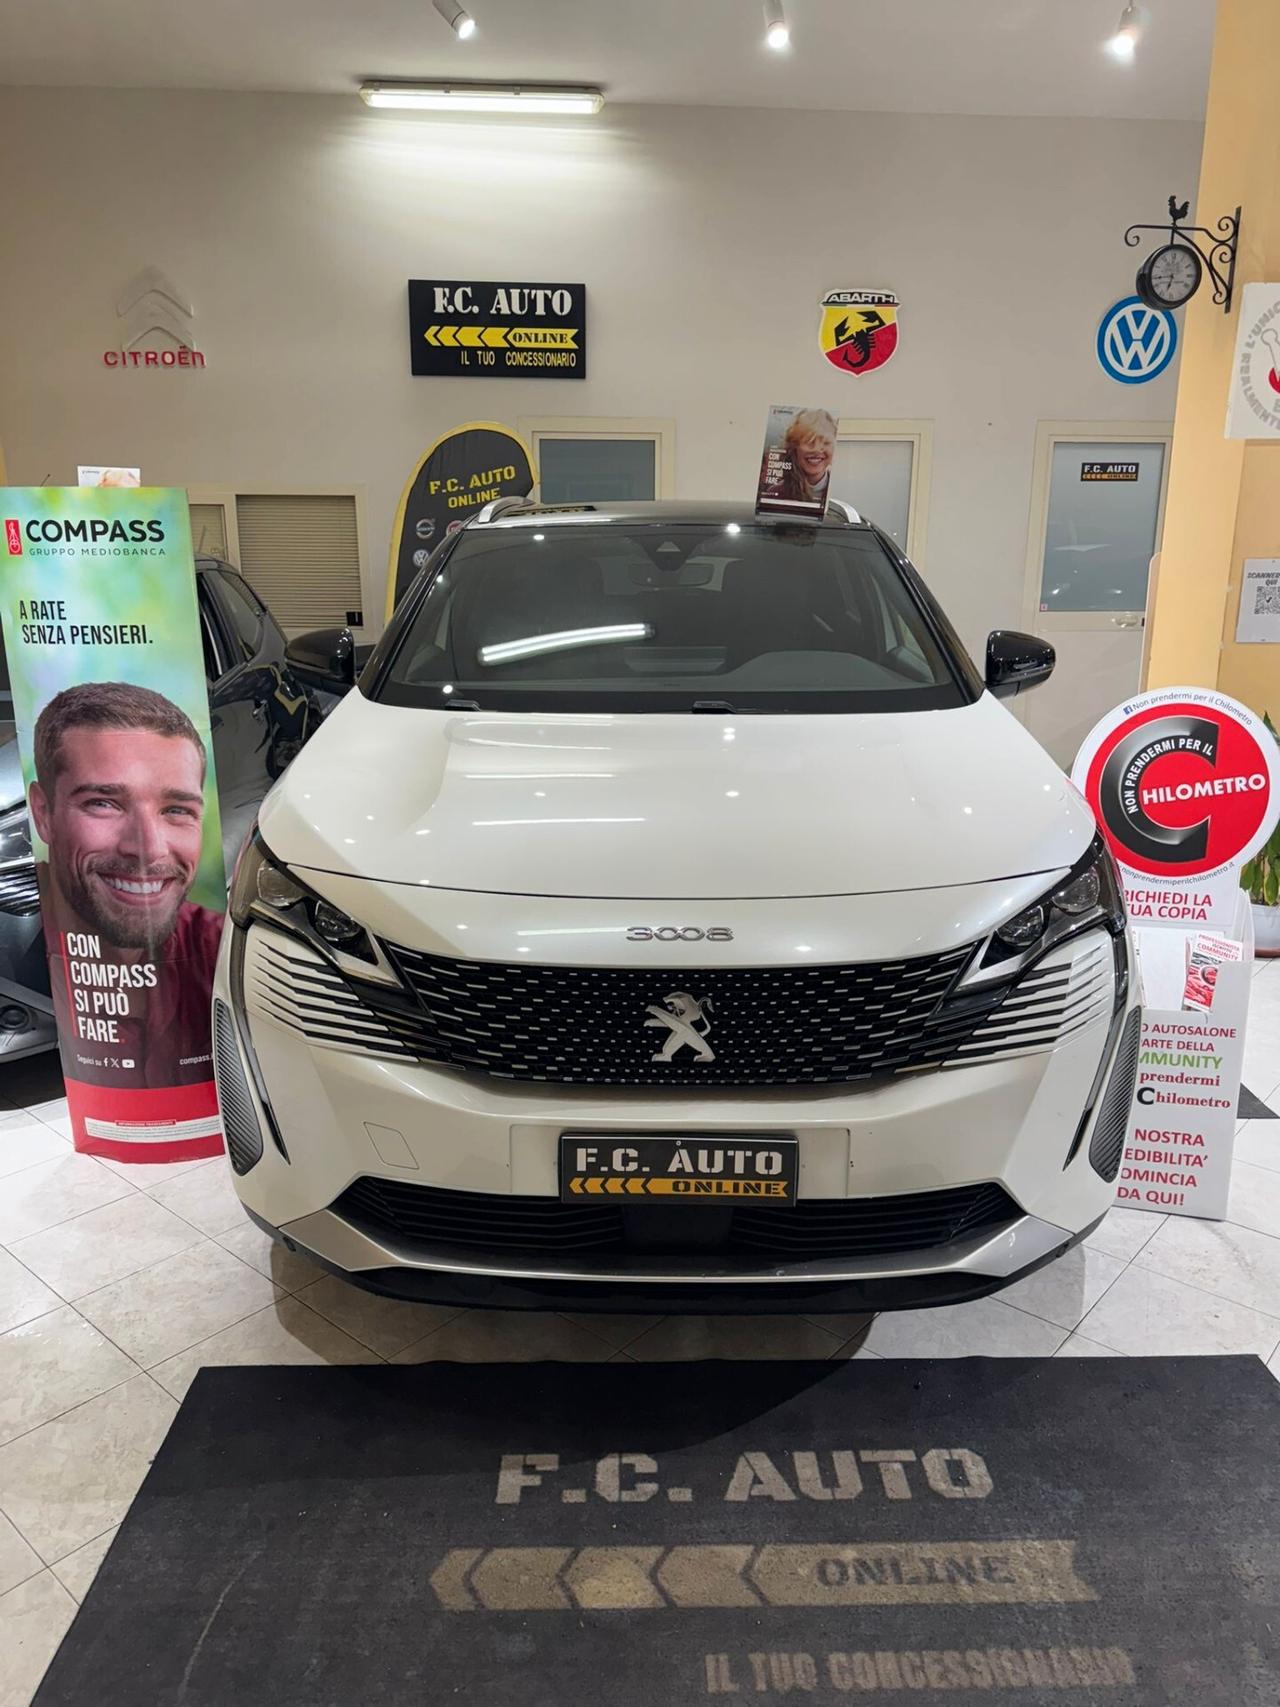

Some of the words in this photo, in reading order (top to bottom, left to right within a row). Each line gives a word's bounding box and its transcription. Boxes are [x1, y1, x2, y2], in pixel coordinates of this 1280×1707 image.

[433, 286, 479, 314] F.C.
[490, 288, 573, 316] AUTO
[828, 292, 894, 304] ABARTH
[512, 332, 569, 344] ONLINE
[461, 351, 470, 365] IL
[477, 351, 496, 366] TUO
[505, 352, 577, 368] CONCESSIONARIO
[1084, 464, 1103, 473] F.C.
[1107, 465, 1136, 473] AUTO
[429, 478, 464, 495] F.C.
[469, 465, 516, 489] AUTO
[448, 488, 500, 508] ONLINE
[26, 519, 165, 542] COMPASS
[29, 548, 75, 556] GRUPPO
[82, 548, 166, 556] MEDIOBANCA
[20, 600, 27, 619] A
[31, 600, 67, 620] RATE
[23, 625, 66, 644] SENZA
[70, 625, 153, 645] PENSIERI.
[1133, 700, 1149, 711] Non
[1151, 693, 1192, 704] prendermi
[1194, 694, 1206, 702] per
[1215, 696, 1252, 725] Chilometro
[1178, 738, 1201, 751] PER
[1202, 743, 1213, 756] IL
[1125, 739, 1175, 787] PRENDERMI
[1124, 790, 1139, 814] NON
[1193, 894, 1212, 907] LA
[1127, 904, 1153, 917] UA
[1158, 905, 1207, 920] COPIA
[626, 927, 734, 941] 3008
[67, 932, 101, 958] CON
[70, 961, 158, 988] COMPASS
[75, 989, 90, 1013] SI
[94, 988, 129, 1016] PUÒ
[1152, 1024, 1237, 1038] AUTOSALONE
[1141, 1038, 1173, 1049] ARTE
[1177, 1041, 1214, 1052] DELLA
[1138, 1051, 1223, 1069] MMUNITY
[1139, 1072, 1220, 1086] prendermi
[1137, 1087, 1230, 1108] Chilometro
[1135, 1129, 1205, 1147] NOSTRA
[576, 1148, 650, 1172] F.C.
[667, 1149, 782, 1175] AUTO
[1124, 1148, 1208, 1167] EDIBILITA'
[1121, 1167, 1197, 1187] OMINCIA
[672, 1180, 782, 1195] ONLINE
[1117, 1186, 1141, 1200] DA
[1146, 1190, 1184, 1206] QUI!
[495, 1453, 694, 1504] F.C.
[723, 1448, 994, 1501] AUTO
[816, 1556, 1017, 1586] ONLINE
[705, 1653, 739, 1694] IL
[749, 1652, 817, 1693] TUO
